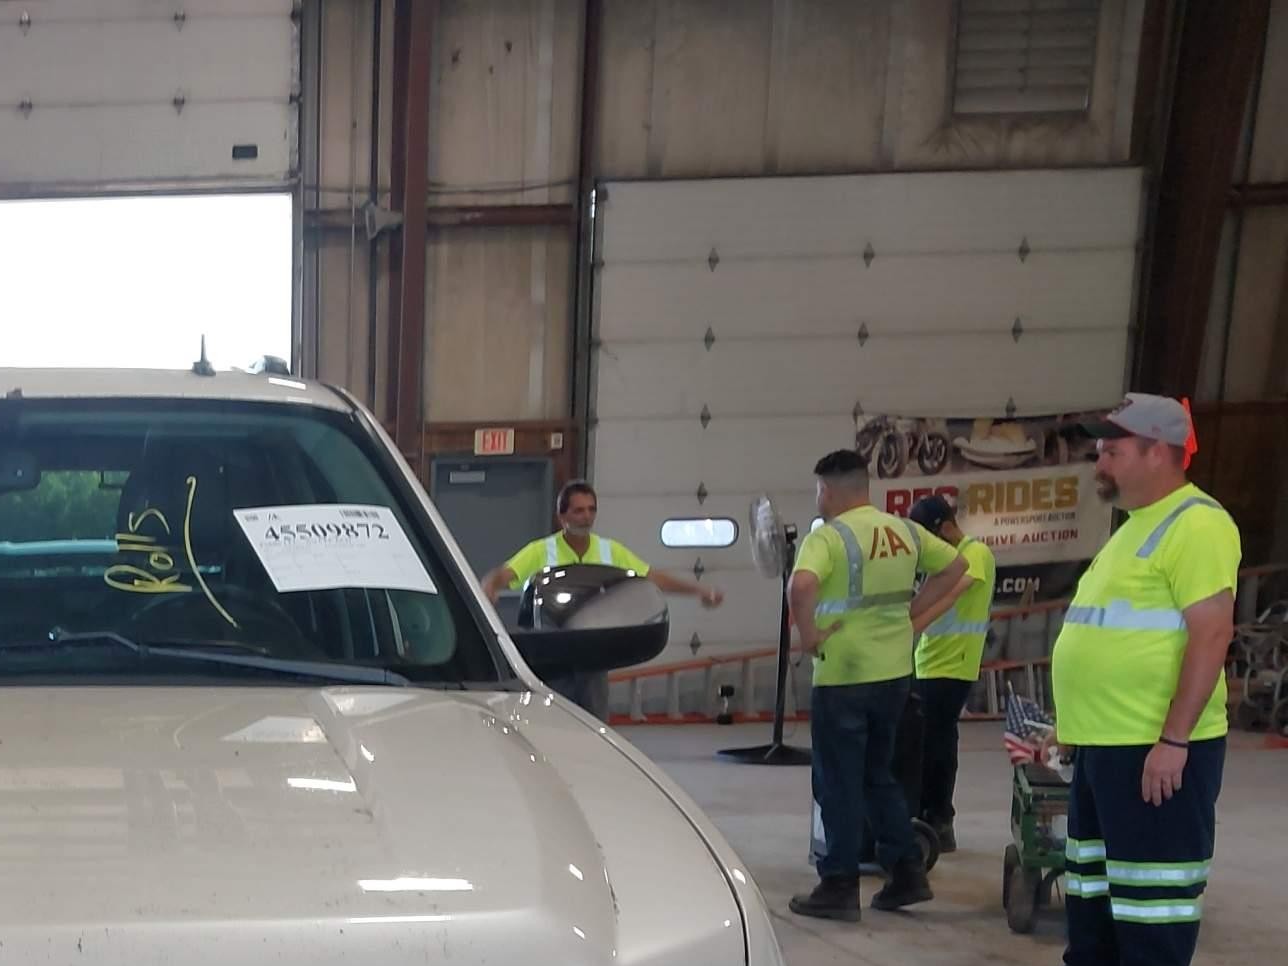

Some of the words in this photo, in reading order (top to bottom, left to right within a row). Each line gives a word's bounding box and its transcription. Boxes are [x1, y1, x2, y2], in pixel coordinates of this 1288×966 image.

[481, 430, 508, 452] EXIT
[966, 476, 1080, 515] RIDES
[265, 521, 390, 542] 45509872
[1021, 528, 1079, 544] AUCTION
